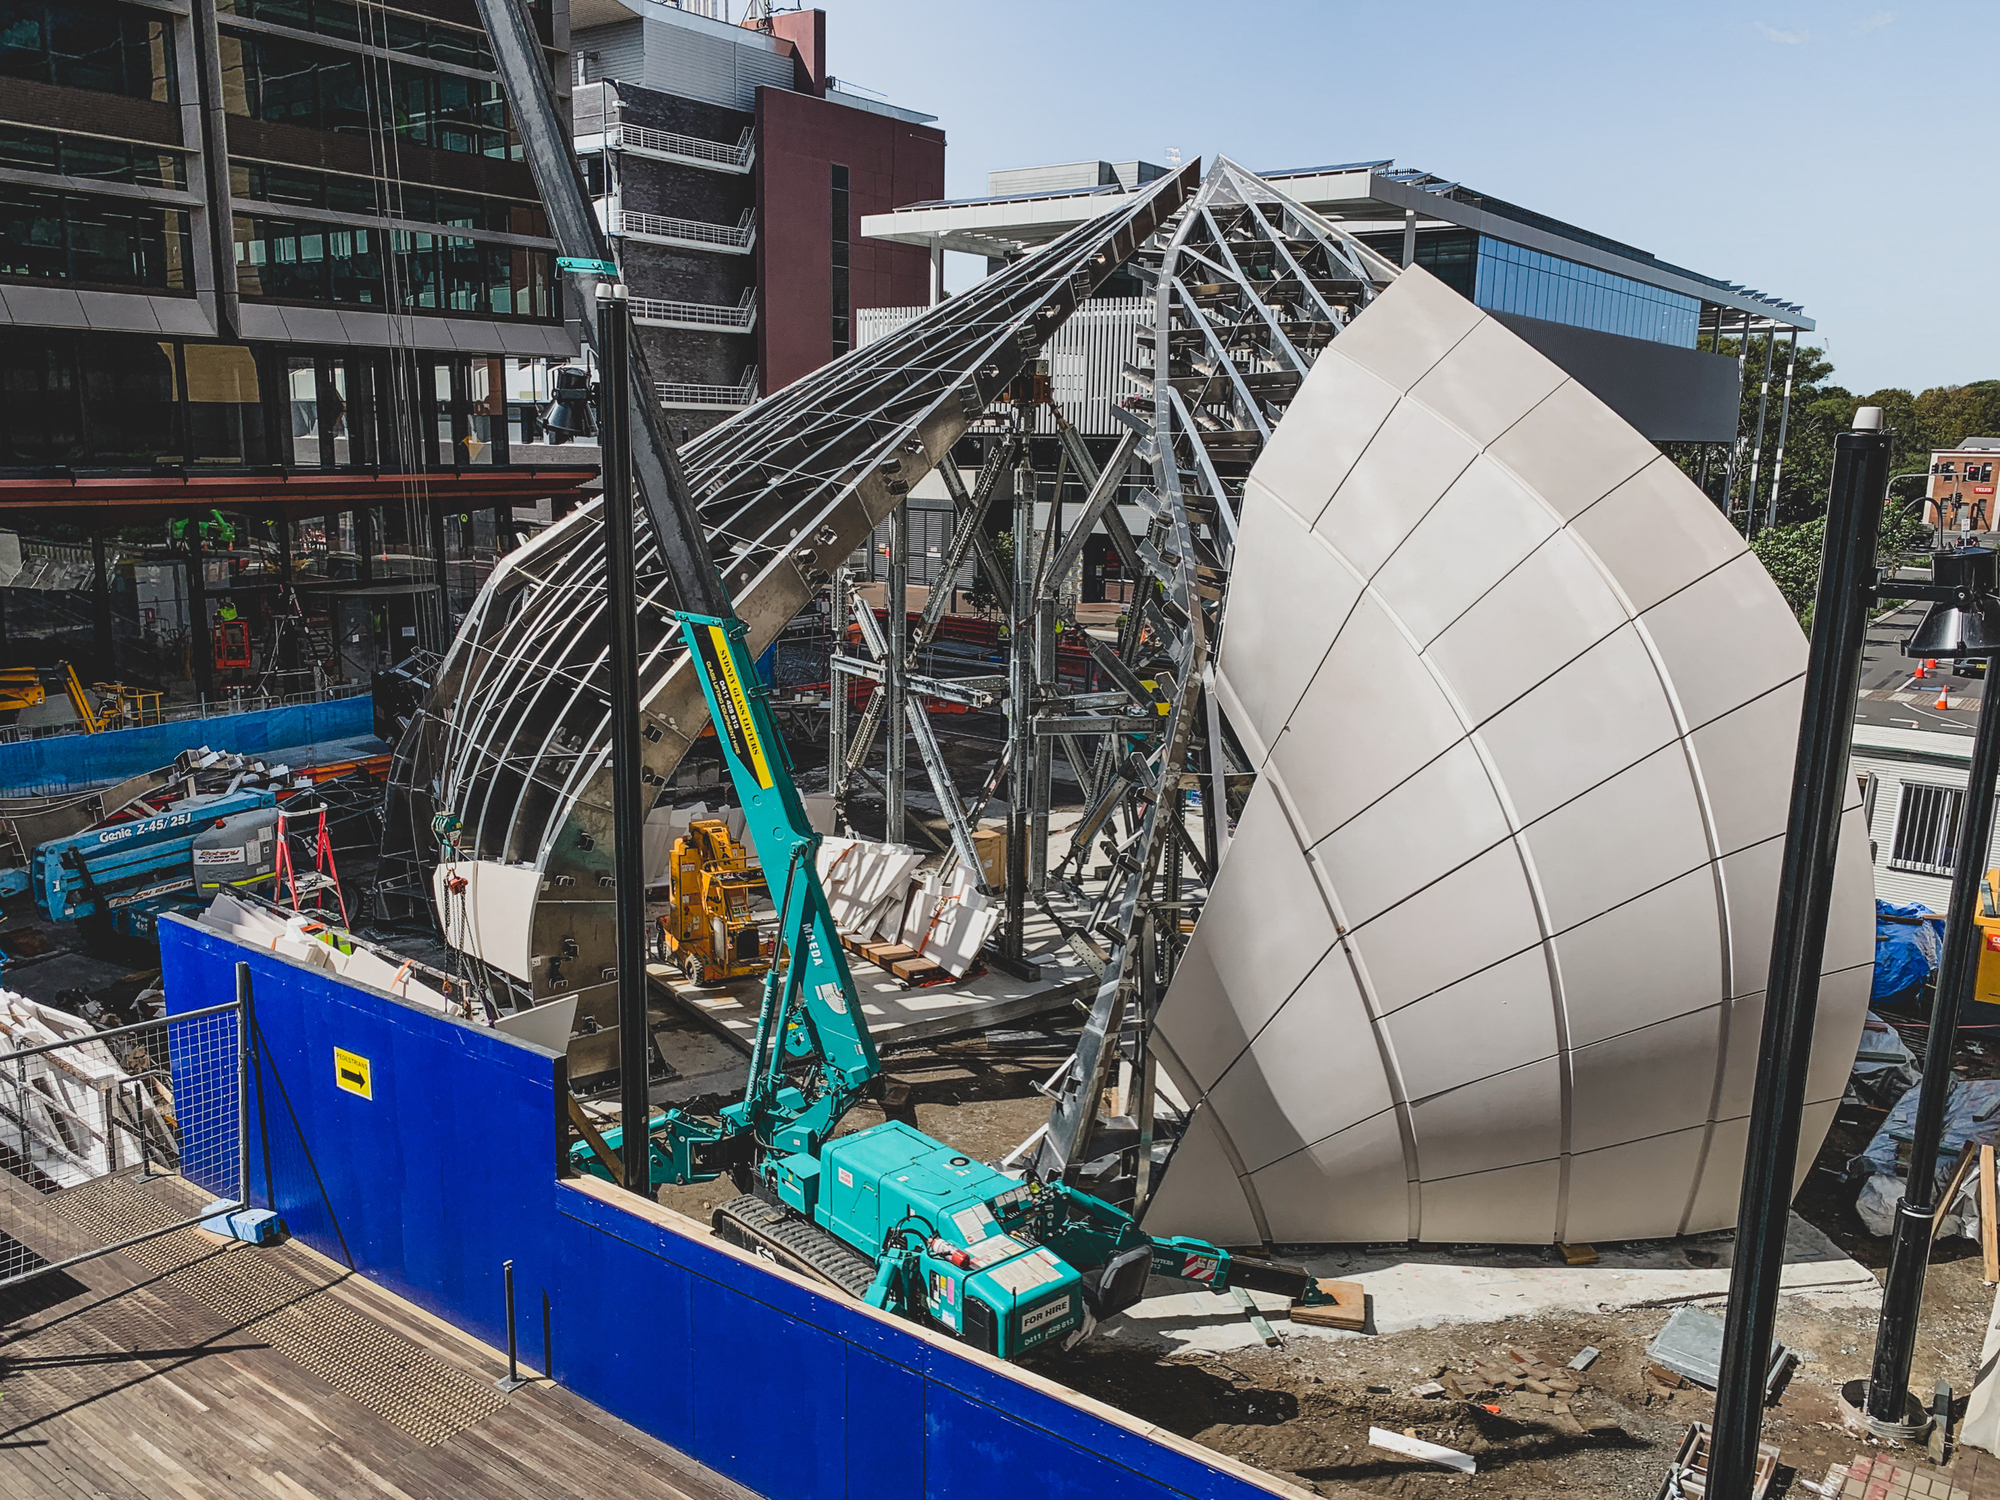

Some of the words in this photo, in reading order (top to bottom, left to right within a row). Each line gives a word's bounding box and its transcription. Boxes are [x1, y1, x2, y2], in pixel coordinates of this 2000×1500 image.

[706, 660, 717, 682] GLASS
[712, 681, 725, 705] LIFTING
[720, 704, 737, 740] EQUIPMENT
[719, 680, 730, 699] 0411
[720, 649, 736, 685] SYDNEY
[733, 687, 746, 716] GLASS
[743, 718, 760, 756] LIFTERS
[99, 828, 133, 843] Genie
[802, 922, 824, 967] MAEDA
[336, 1052, 369, 1071] PEDESTRIANS
[1024, 1312, 1043, 1327] FOR
[1045, 1301, 1067, 1317] HIRE
[1024, 1333, 1042, 1346] 0411
